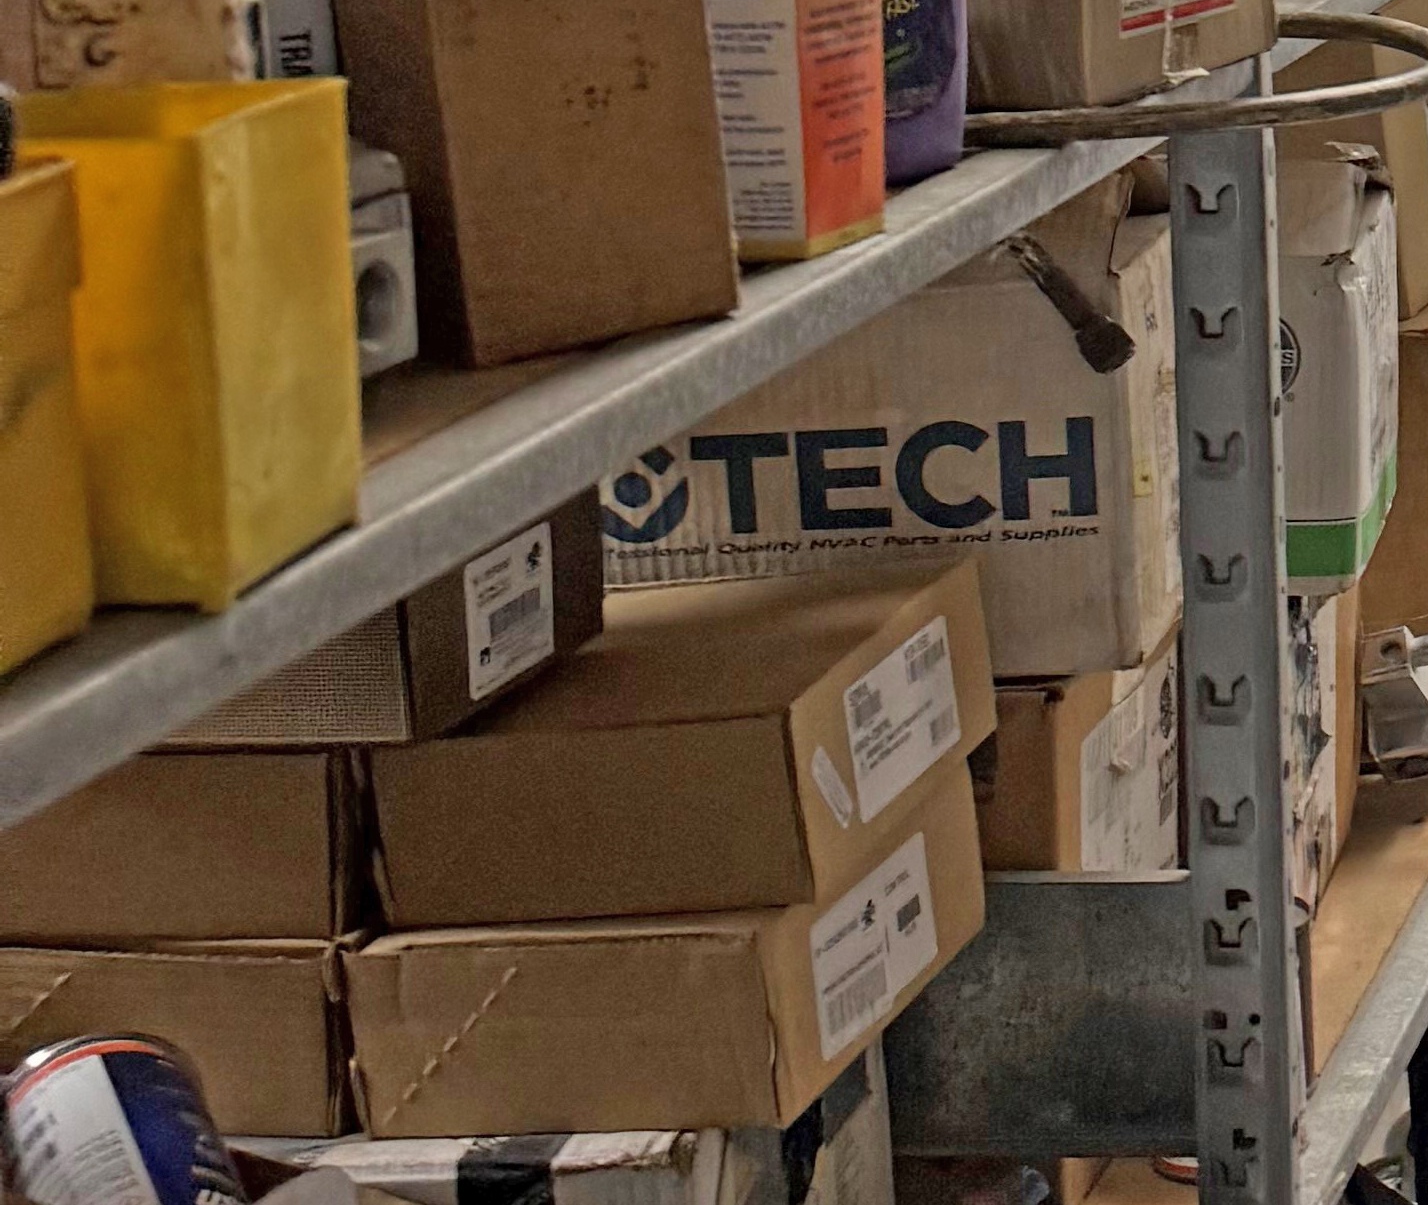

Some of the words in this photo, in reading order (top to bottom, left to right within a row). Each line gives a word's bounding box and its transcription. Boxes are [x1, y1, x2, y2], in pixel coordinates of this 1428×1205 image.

[690, 415, 1099, 534] TECH
[718, 540, 800, 556] Quality
[883, 534, 940, 548] Parts
[949, 530, 992, 544] and
[1001, 524, 1100, 544] Supplies
